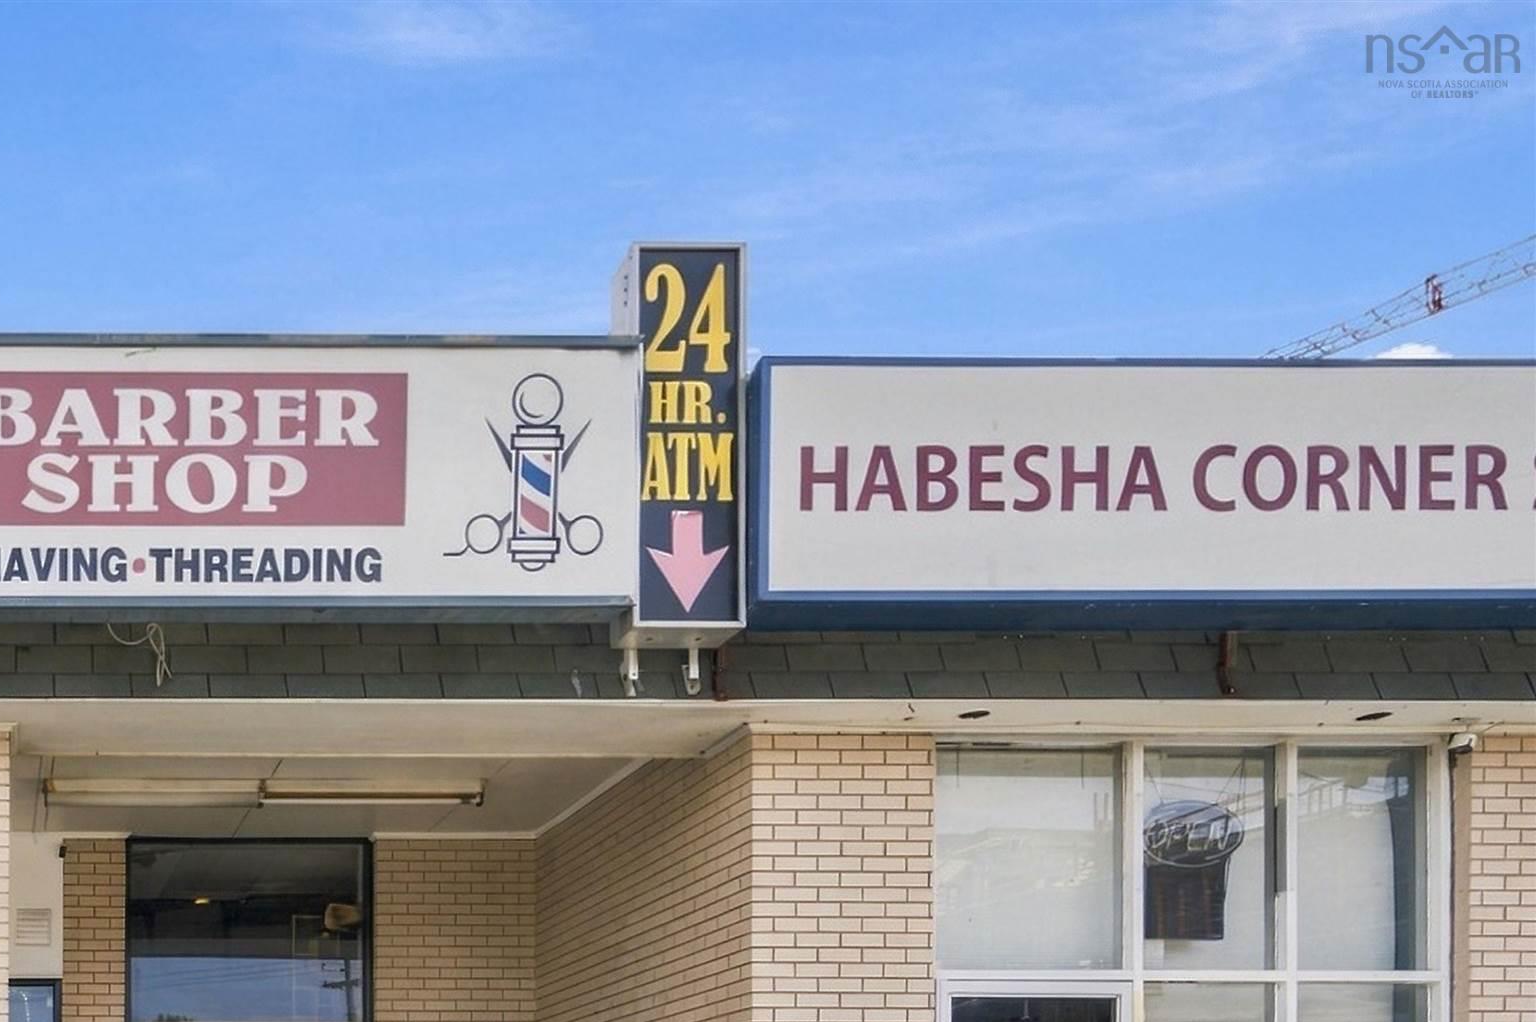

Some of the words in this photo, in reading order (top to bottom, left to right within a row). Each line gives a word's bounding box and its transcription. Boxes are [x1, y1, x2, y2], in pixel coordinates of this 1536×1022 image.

[645, 263, 731, 373] 24
[648, 381, 727, 424] HR.
[21, 453, 309, 515] SHOP
[641, 432, 734, 501] ATM
[799, 445, 1168, 512] HABESHA
[1193, 444, 1508, 512] CORNER
[148, 548, 383, 583] THREADING
